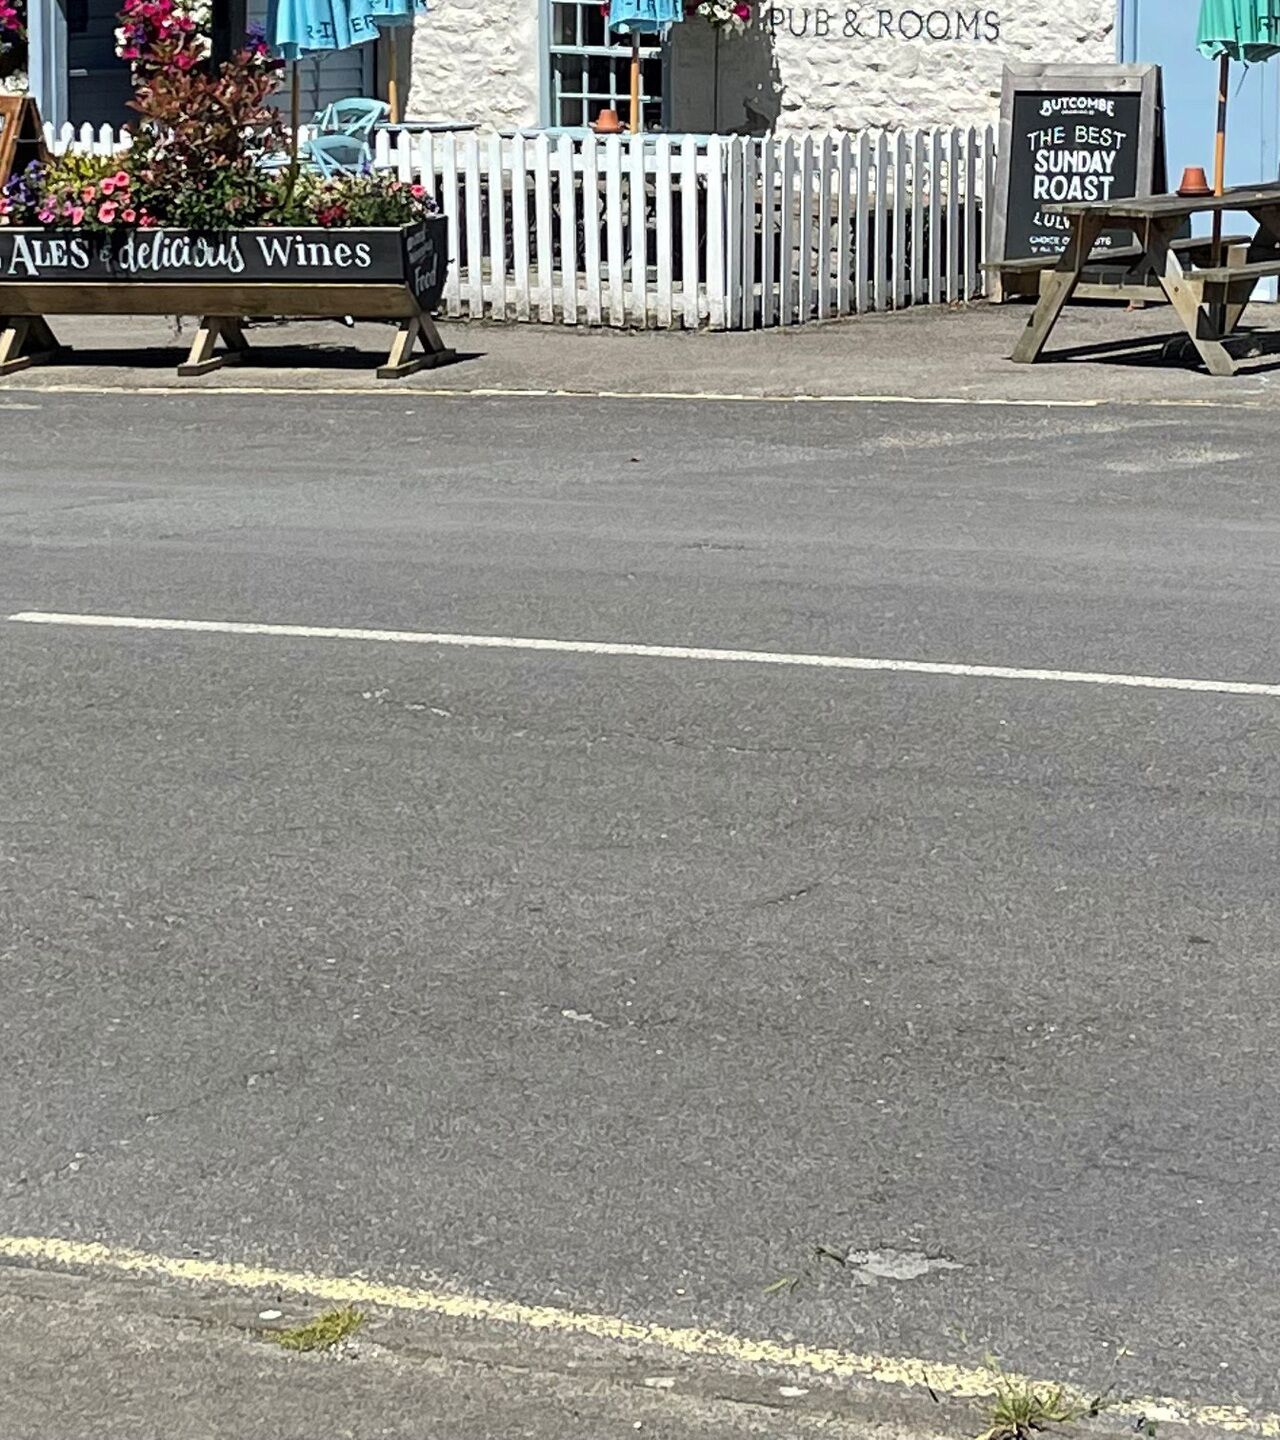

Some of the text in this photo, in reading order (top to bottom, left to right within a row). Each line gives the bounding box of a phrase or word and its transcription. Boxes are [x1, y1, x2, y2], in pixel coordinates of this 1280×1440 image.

[770, 7, 1002, 43] PUB & ROOMS
[1038, 96, 1116, 118] BUTCOMBE
[1026, 125, 1127, 152] THE BEST
[1034, 149, 1117, 174] SUNDAY
[1033, 174, 1115, 201] ROAST
[7, 234, 91, 277] ALES
[119, 230, 246, 274] delicious
[256, 234, 372, 268] Wines
